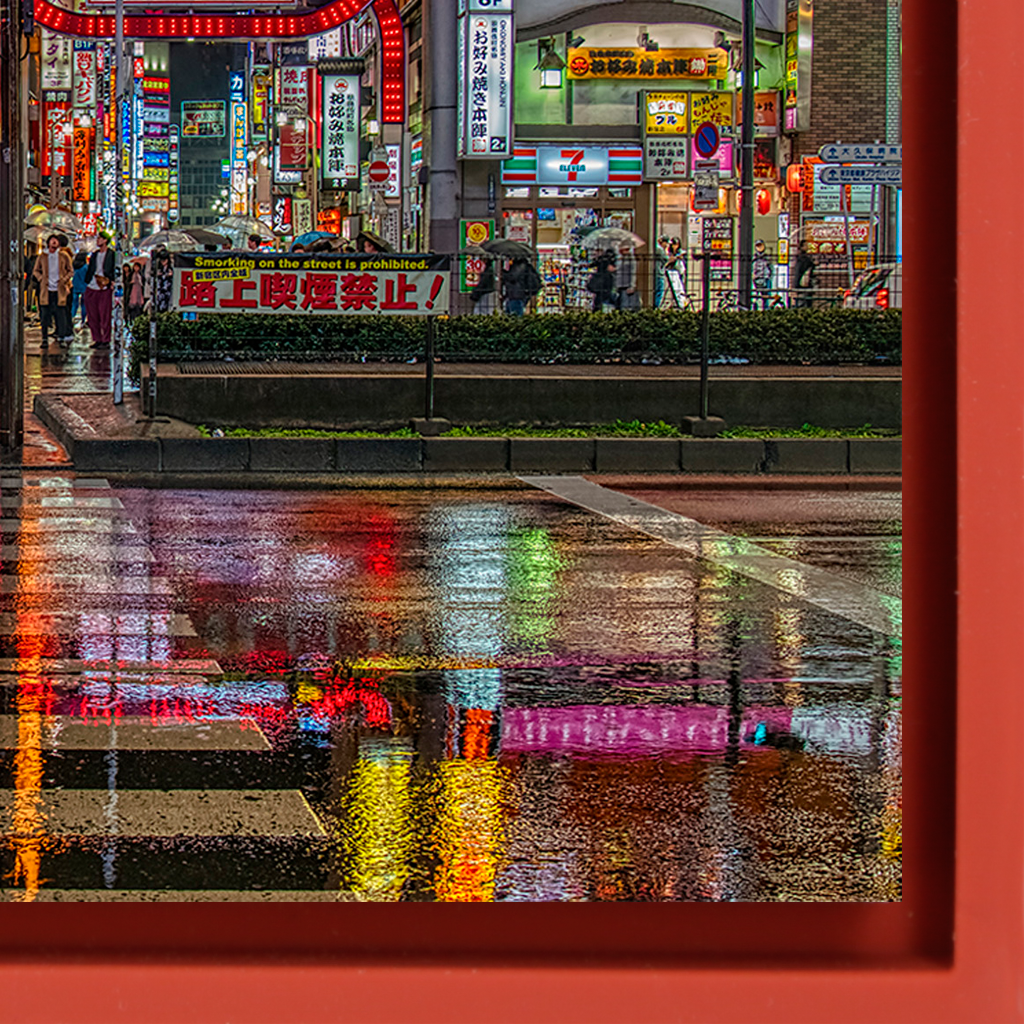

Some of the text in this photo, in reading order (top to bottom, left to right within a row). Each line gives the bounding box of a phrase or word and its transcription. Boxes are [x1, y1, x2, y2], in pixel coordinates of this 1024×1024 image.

[472, 30, 488, 138] お好み焼き本陣
[491, 138, 506, 151] 2F
[561, 150, 585, 182] 7
[332, 178, 349, 188] 2F
[194, 256, 429, 271] Smorking on the street is prohibited.
[179, 270, 444, 311] 路上喫煙禁止!
